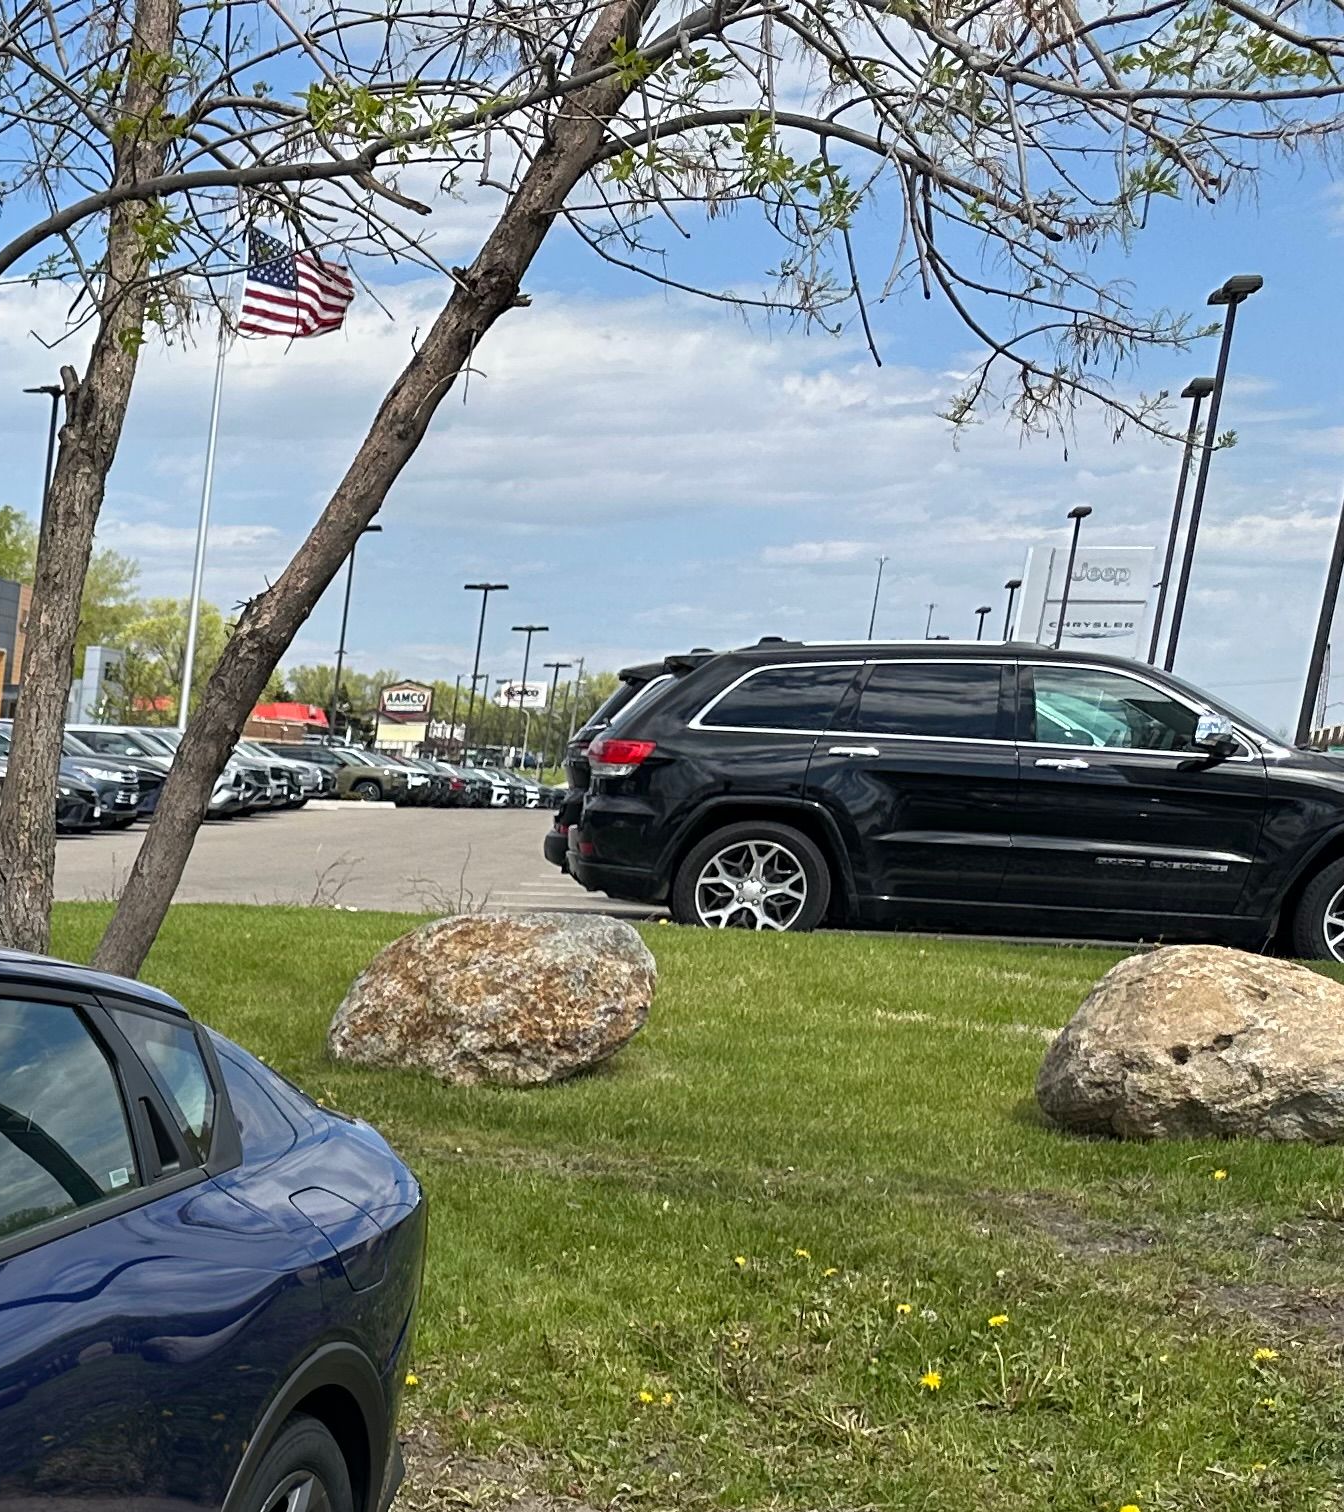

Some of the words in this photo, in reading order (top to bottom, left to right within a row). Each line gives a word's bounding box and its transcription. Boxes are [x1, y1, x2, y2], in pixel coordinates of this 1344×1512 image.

[1072, 562, 1131, 585] Jeep
[1049, 621, 1134, 629] CHRYSLER
[386, 692, 426, 704] AAMCO
